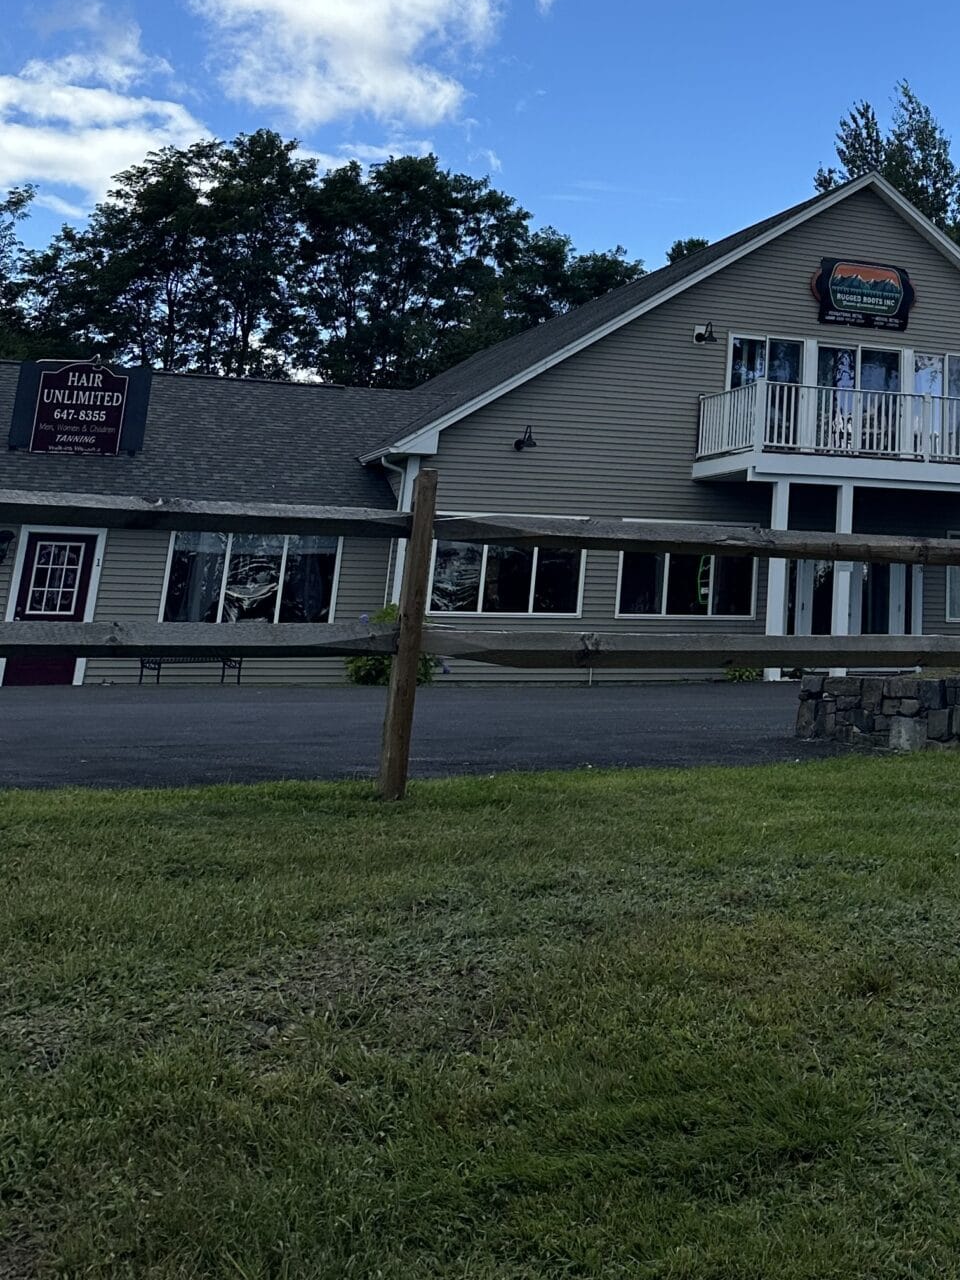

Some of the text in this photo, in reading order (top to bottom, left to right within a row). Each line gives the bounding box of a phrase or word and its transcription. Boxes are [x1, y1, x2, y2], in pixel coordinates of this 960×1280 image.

[836, 293, 862, 302] RUGGED
[862, 296, 884, 305] ROOTS
[67, 372, 103, 387] HAIR
[43, 389, 122, 406] UNLIMITED
[53, 409, 106, 421] 647-8355
[55, 434, 96, 444] TANNING
